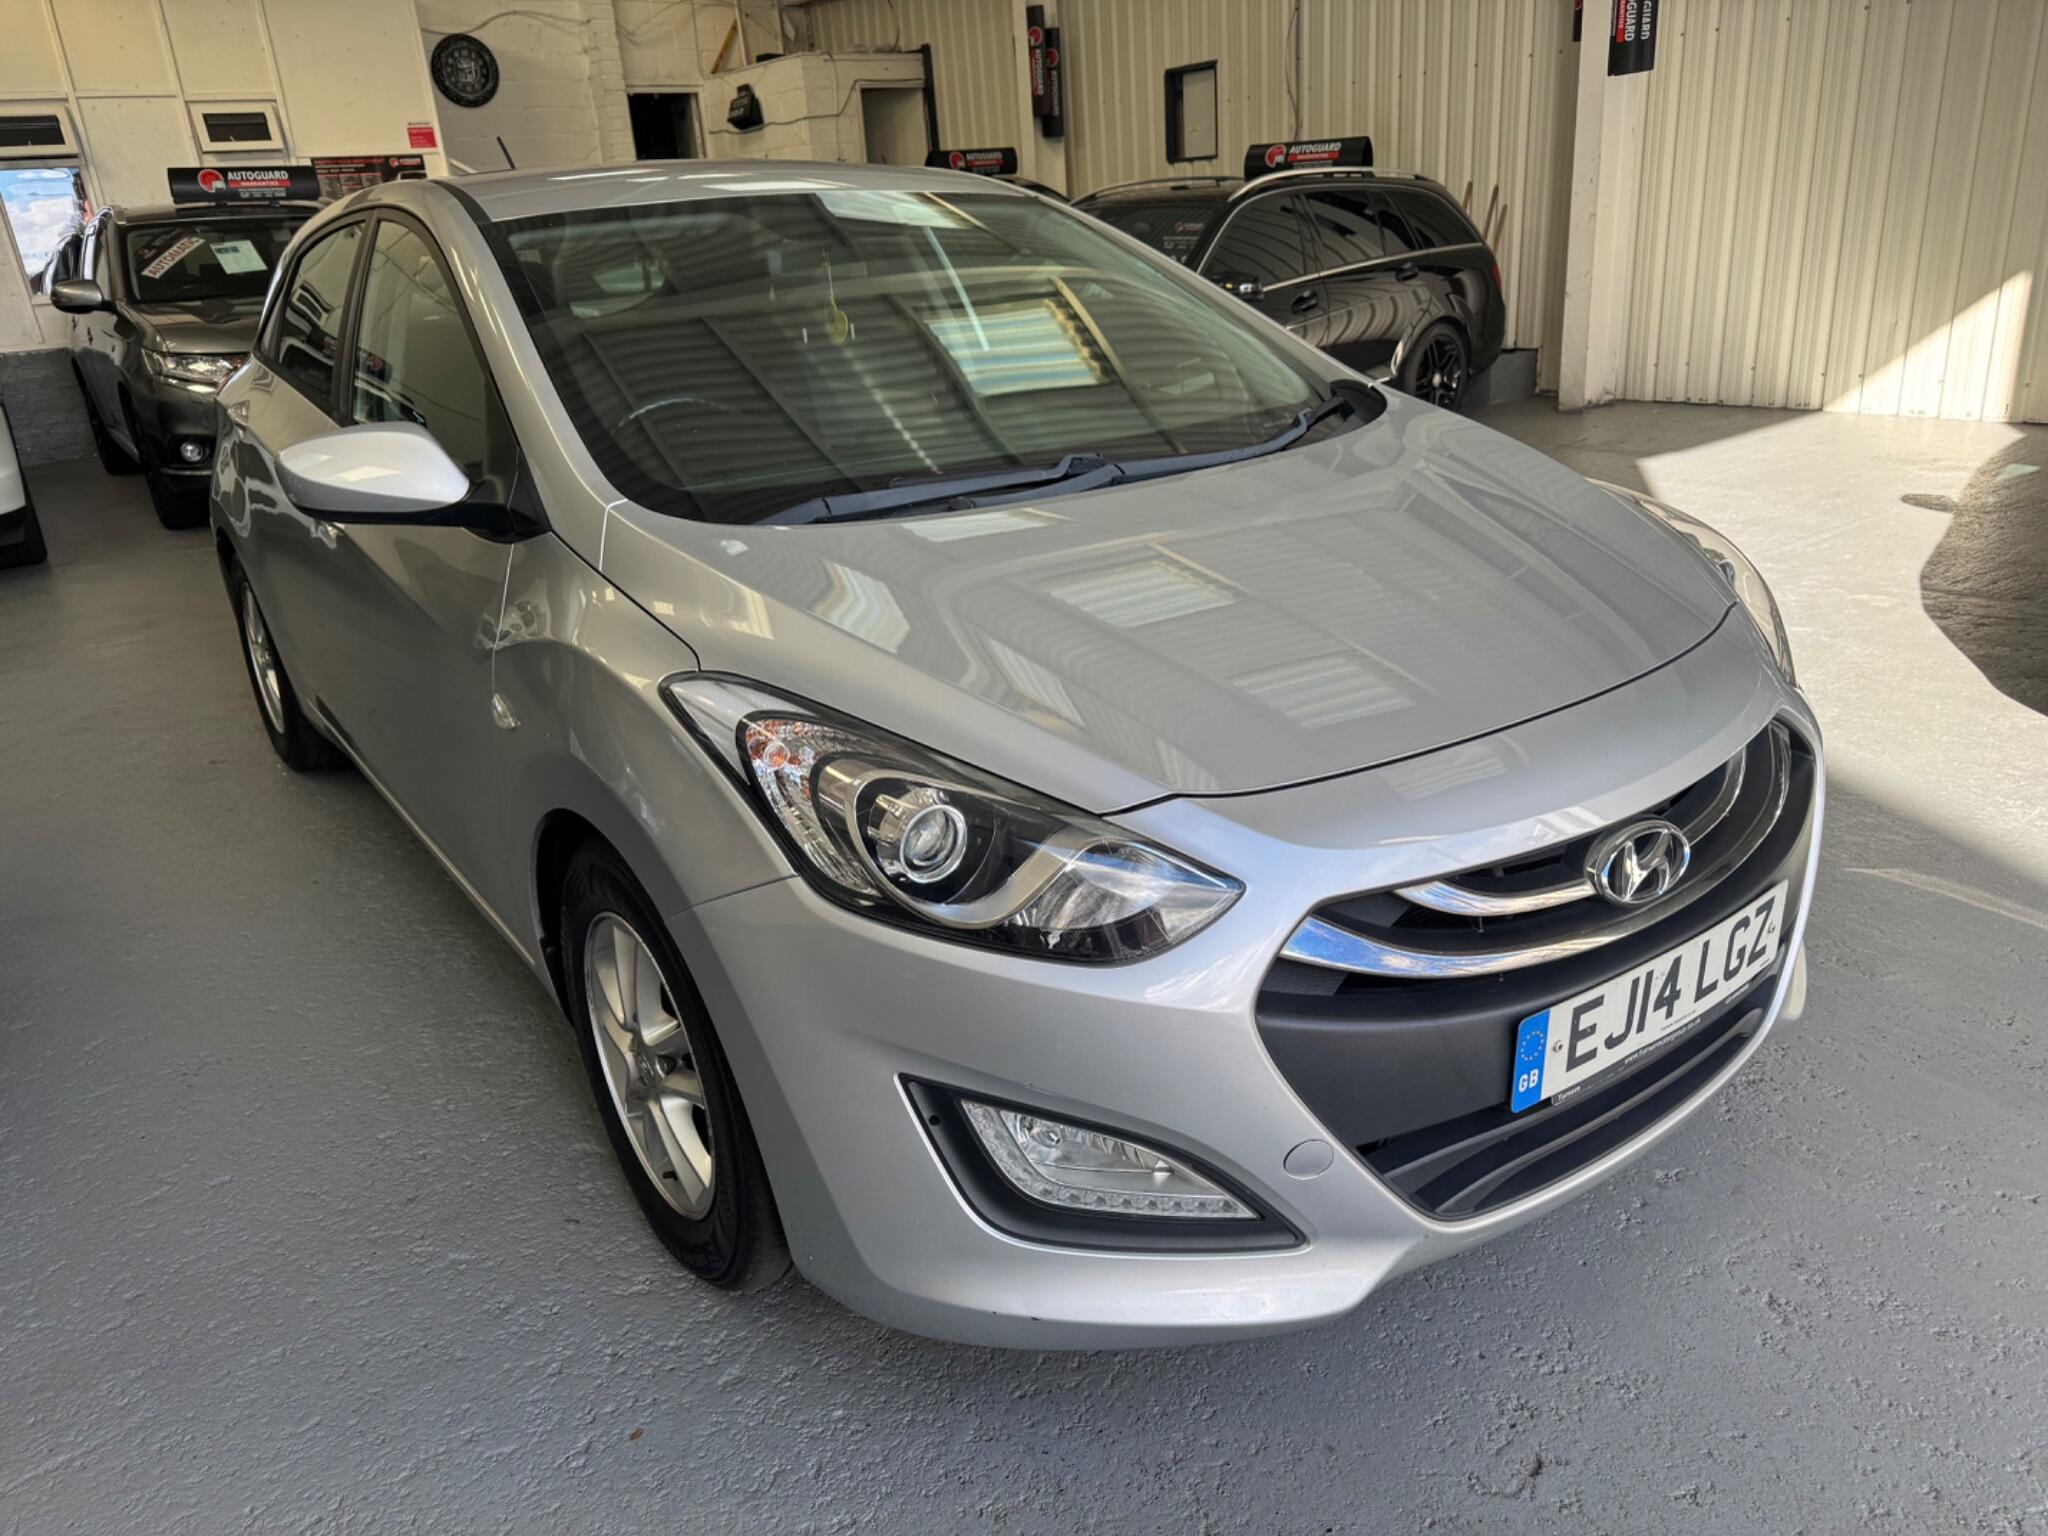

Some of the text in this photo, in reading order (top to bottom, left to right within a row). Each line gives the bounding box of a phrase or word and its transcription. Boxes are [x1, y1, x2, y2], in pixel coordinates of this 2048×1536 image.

[1288, 142, 1342, 154] AUTOGUARD
[227, 170, 289, 181] AUTOGUARD
[148, 238, 200, 277] AUTOMATIC
[1566, 895, 1775, 1073] EJ14 LGZ
[1518, 1068, 1539, 1092] GB
